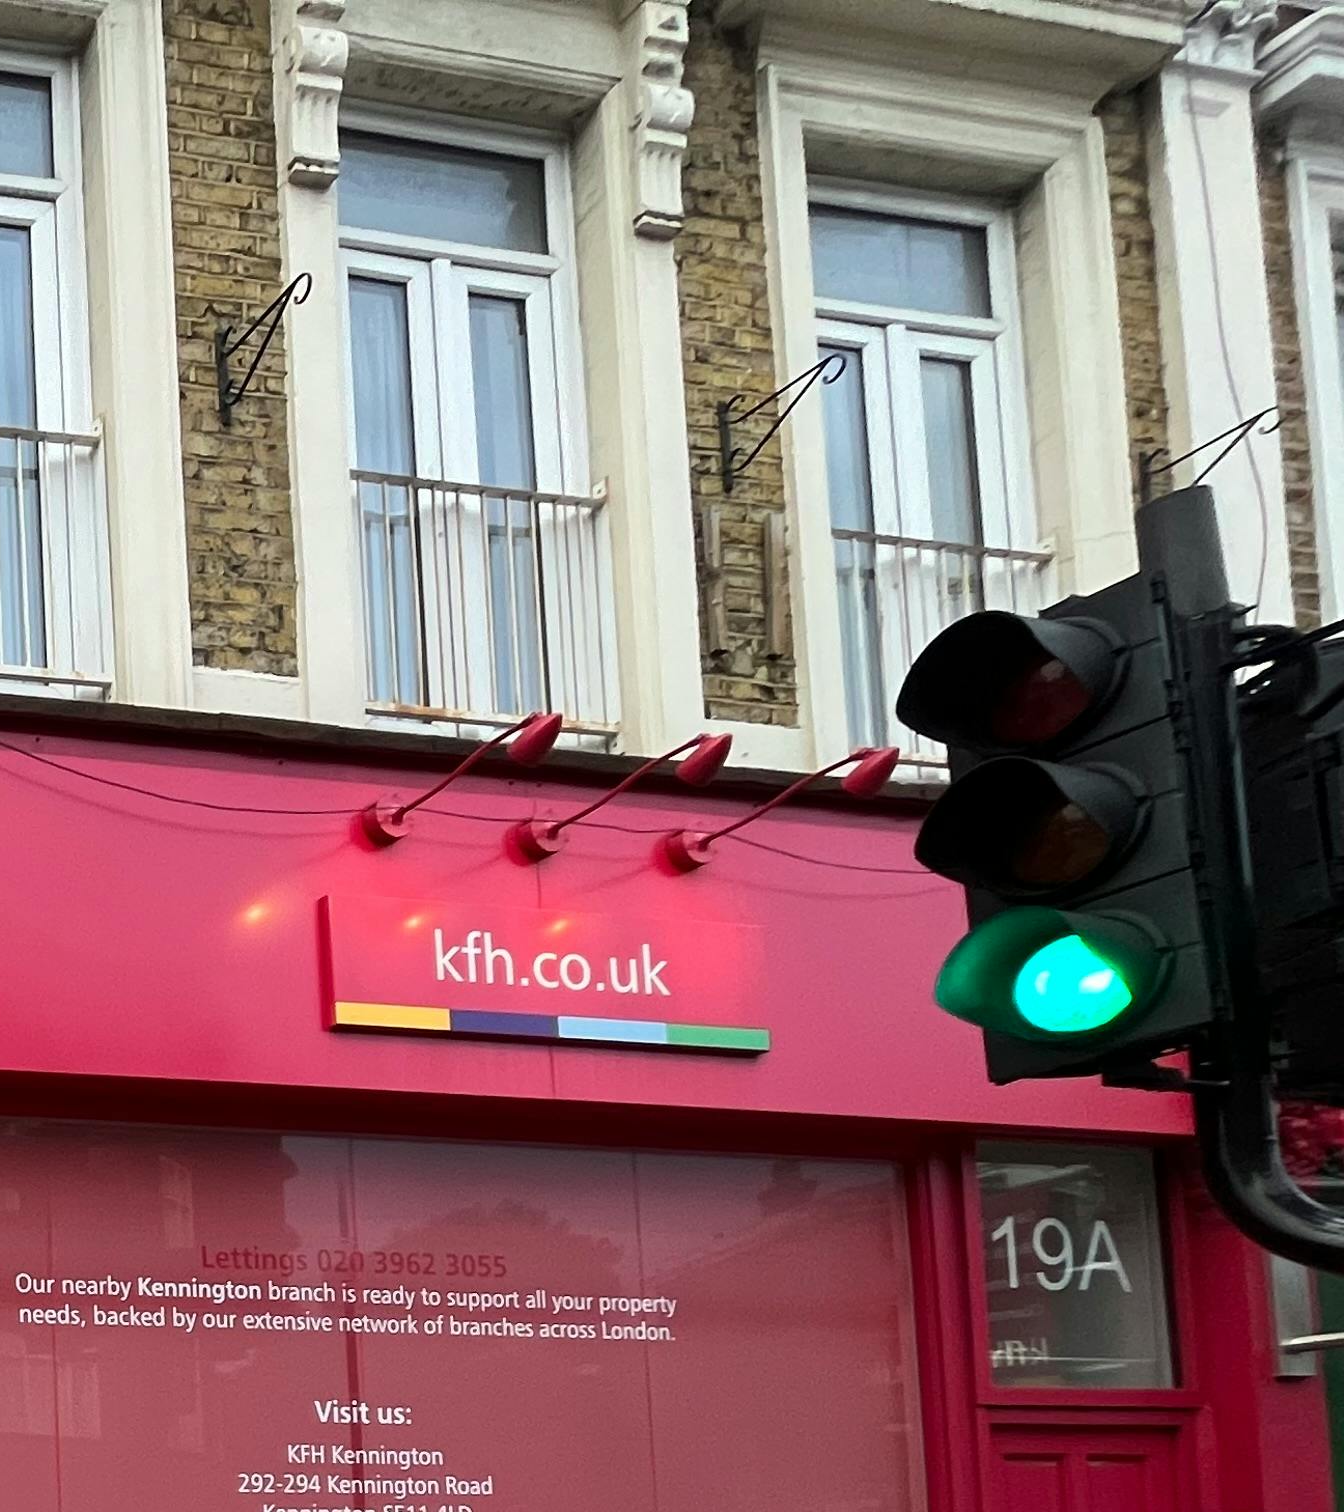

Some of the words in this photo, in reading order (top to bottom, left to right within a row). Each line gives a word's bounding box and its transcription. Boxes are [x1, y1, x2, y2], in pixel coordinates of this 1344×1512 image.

[433, 928, 671, 996] kfh.co.uk
[201, 1245, 308, 1275] Lettings
[317, 1249, 365, 1273] 020
[373, 1251, 437, 1275] 3962
[445, 1253, 507, 1278] 3055
[990, 1214, 1133, 1293] 19A
[15, 1272, 56, 1294] Our
[61, 1275, 132, 1301] nearby
[137, 1276, 262, 1304] Kennington
[268, 1280, 336, 1302] branch
[342, 1282, 357, 1303] is
[362, 1285, 416, 1310] ready
[420, 1287, 441, 1306] to
[446, 1291, 520, 1312] support
[525, 1289, 546, 1309] all
[551, 1295, 594, 1315] your
[599, 1296, 677, 1318] property
[19, 1305, 86, 1328] needs,
[93, 1304, 166, 1327] backed
[172, 1307, 197, 1333] by
[202, 1313, 237, 1329] our
[242, 1310, 333, 1332] extensive
[338, 1314, 419, 1334] network
[423, 1314, 444, 1335] of
[449, 1315, 534, 1338] branches
[539, 1323, 597, 1339] across
[601, 1320, 676, 1341] London.
[313, 1399, 371, 1425] Visit
[377, 1407, 412, 1425] us:
[287, 1444, 325, 1464] KFH
[331, 1445, 444, 1470] Kennington
[238, 1473, 321, 1494] 292-294
[327, 1474, 440, 1500] Kennington
[445, 1475, 493, 1495] Road
